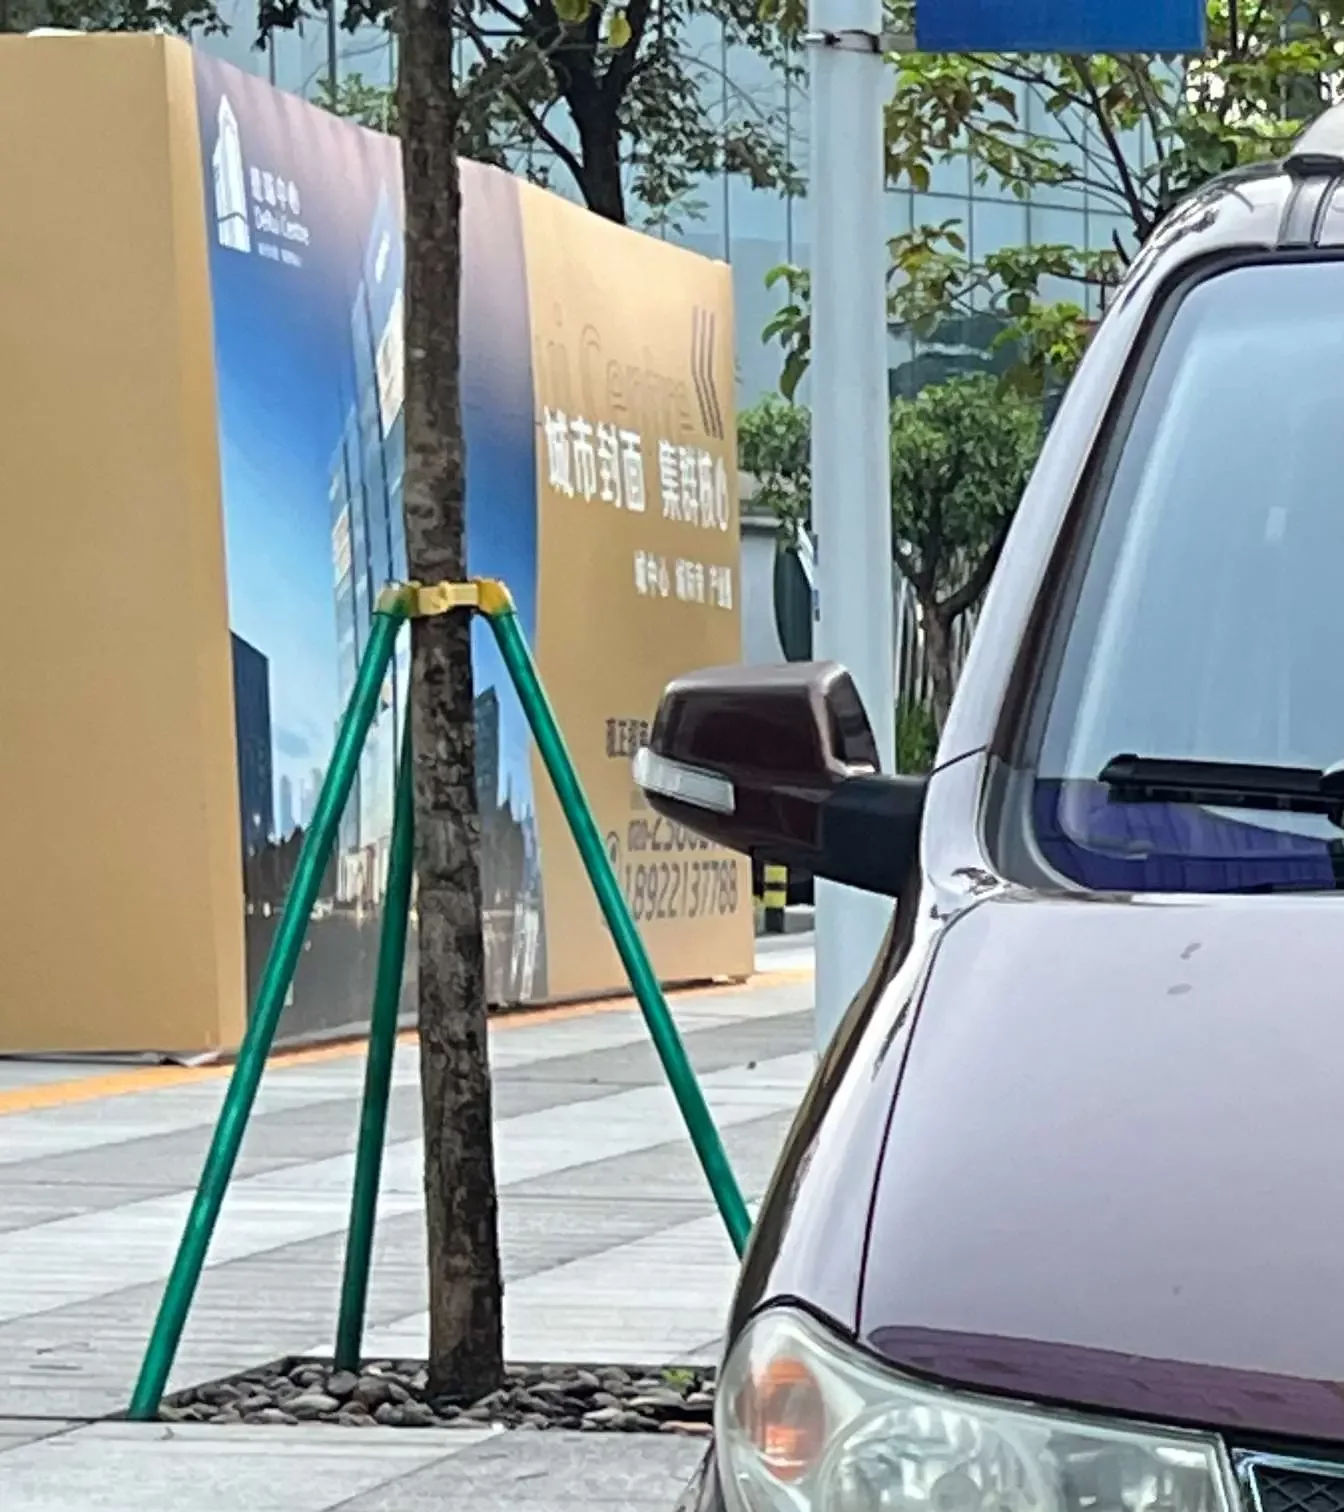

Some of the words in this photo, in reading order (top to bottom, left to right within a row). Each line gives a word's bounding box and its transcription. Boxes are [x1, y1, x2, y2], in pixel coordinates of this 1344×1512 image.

[544, 404, 645, 513] 城市封面
[658, 438, 730, 532] 集群核心
